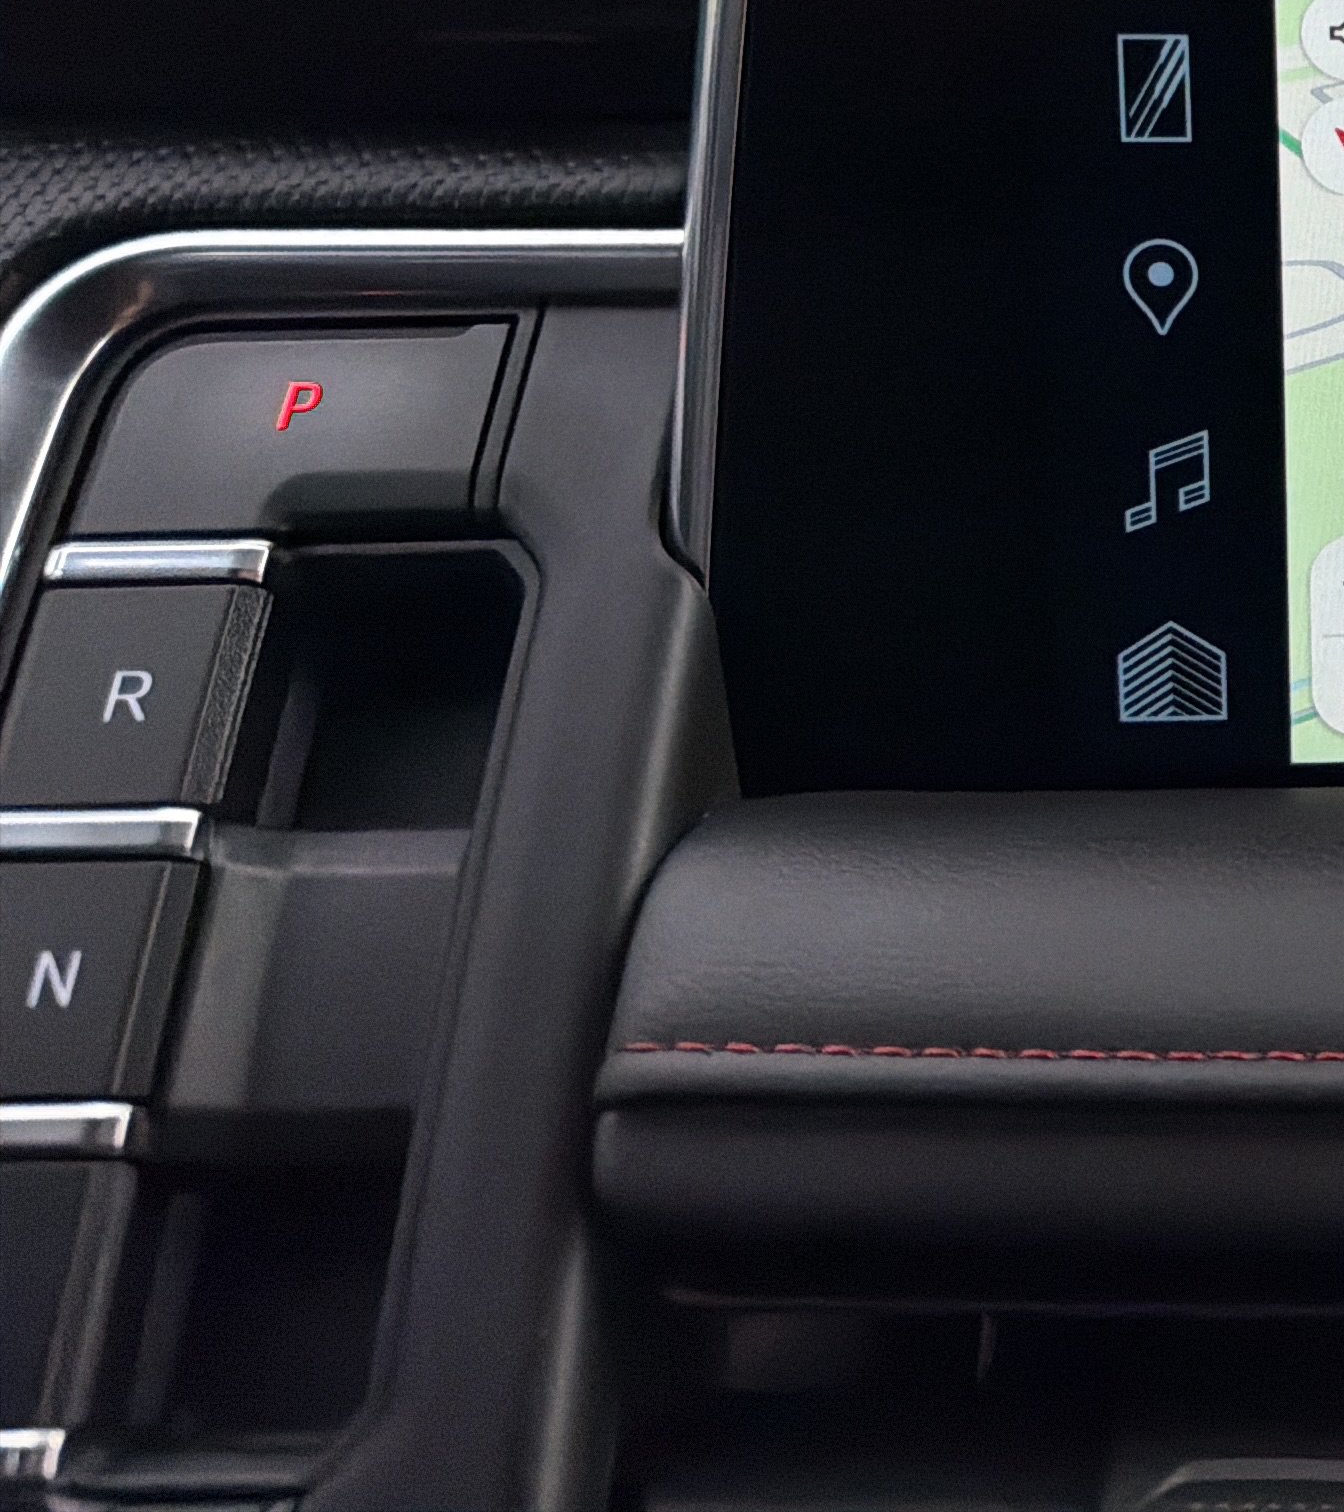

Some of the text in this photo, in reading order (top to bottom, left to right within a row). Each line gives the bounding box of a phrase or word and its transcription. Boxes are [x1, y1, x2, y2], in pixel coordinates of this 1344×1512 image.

[275, 380, 324, 431] P
[103, 669, 154, 724] R
[26, 949, 83, 1009] N
